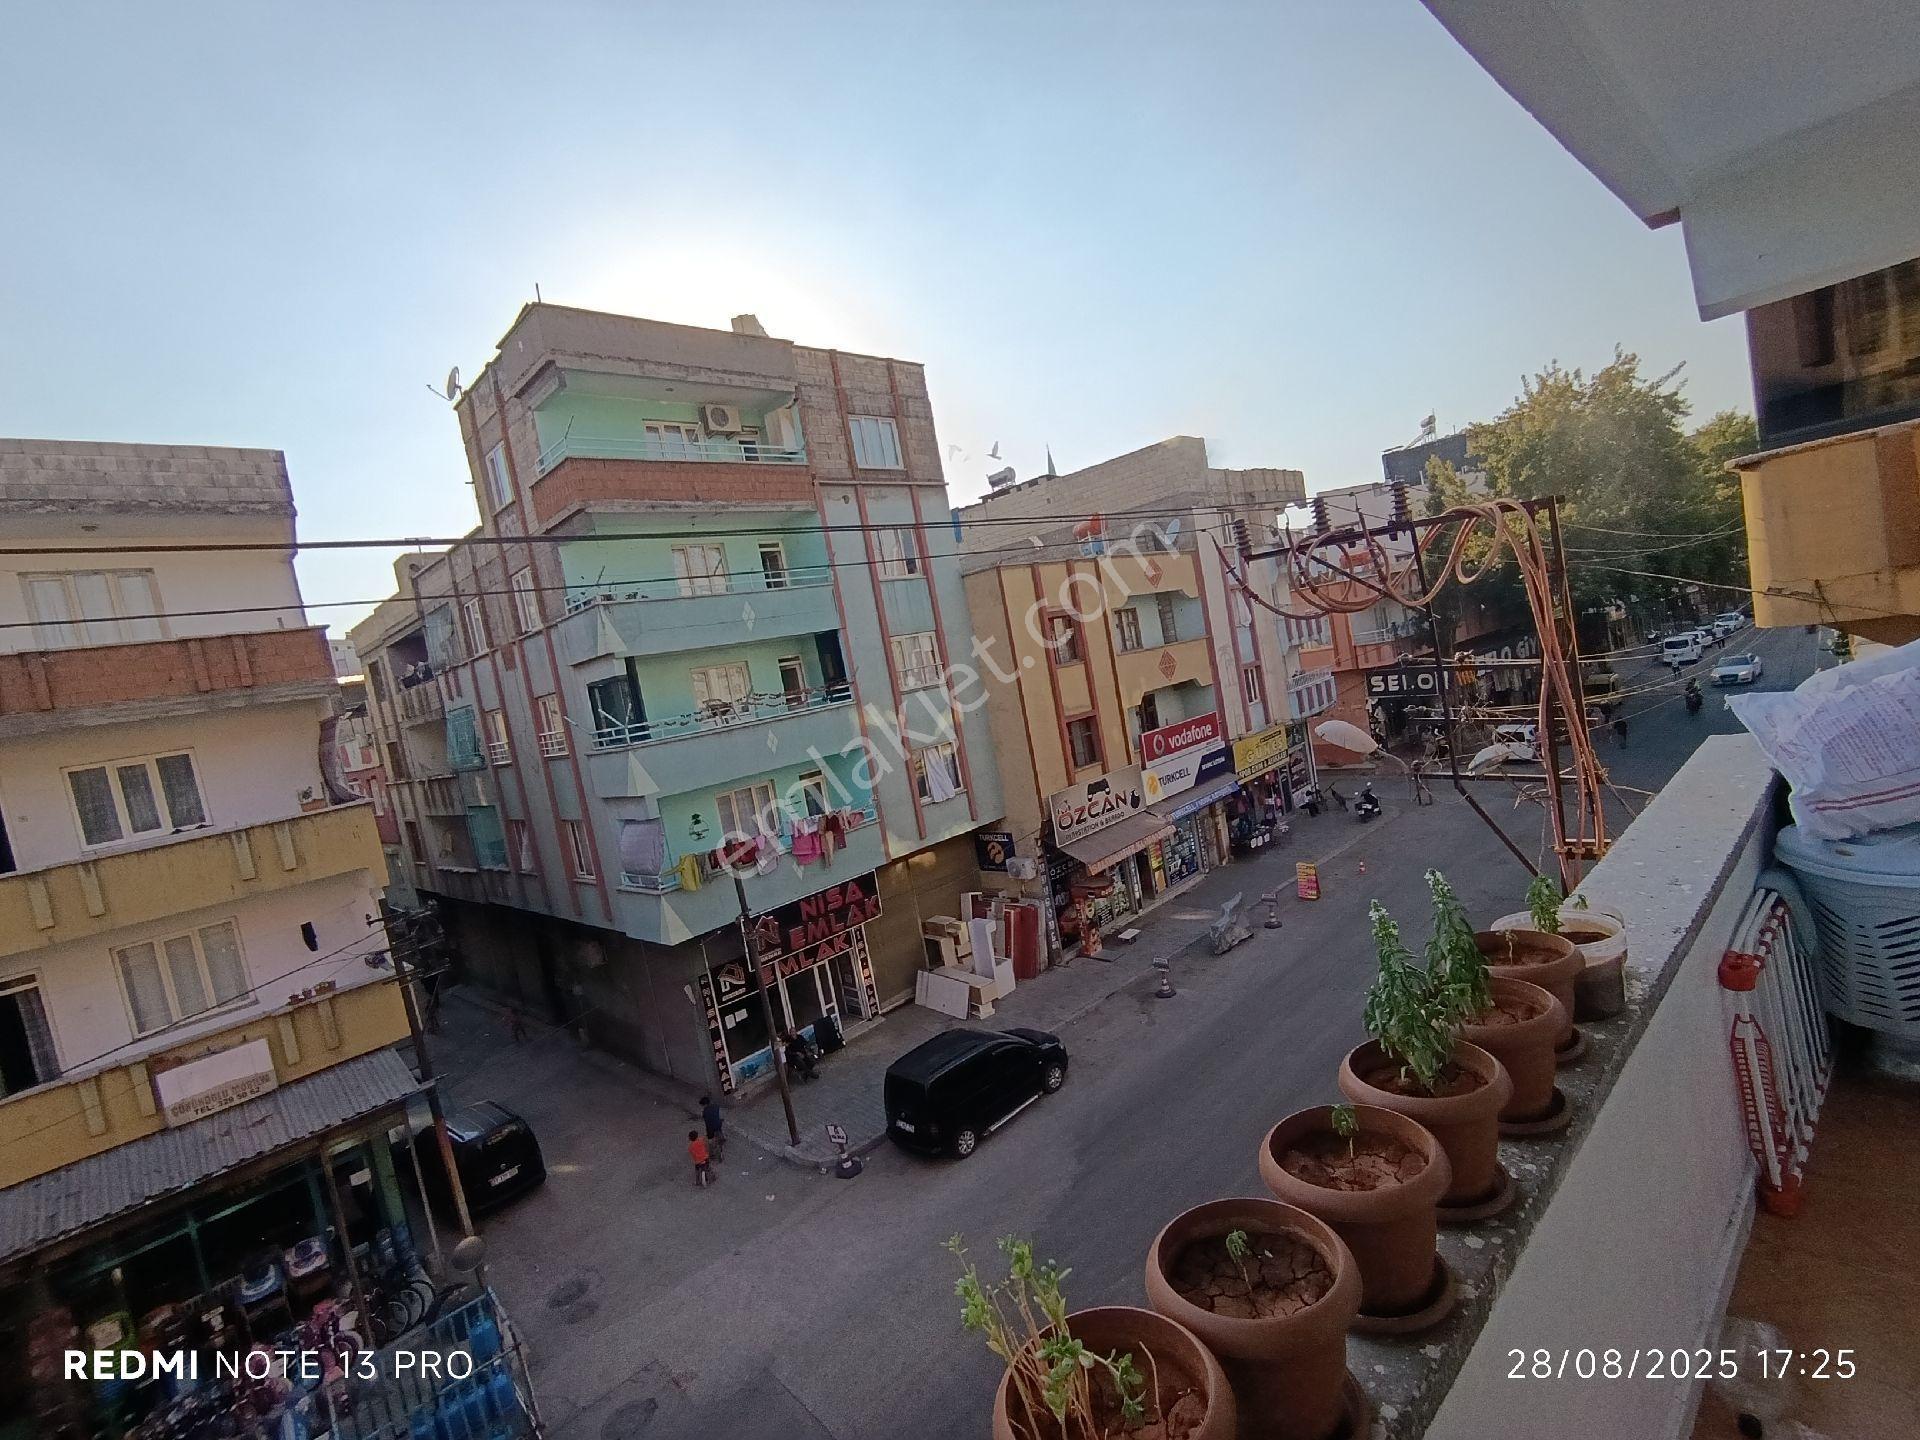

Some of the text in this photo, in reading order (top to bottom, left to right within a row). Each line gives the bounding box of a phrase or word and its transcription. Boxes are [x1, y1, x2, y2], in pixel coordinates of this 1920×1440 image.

[1168, 722, 1213, 749] vodafone
[1157, 768, 1192, 787] TURKCELL
[978, 834, 1010, 842] TURKCELL
[789, 894, 878, 951] EMLAK
